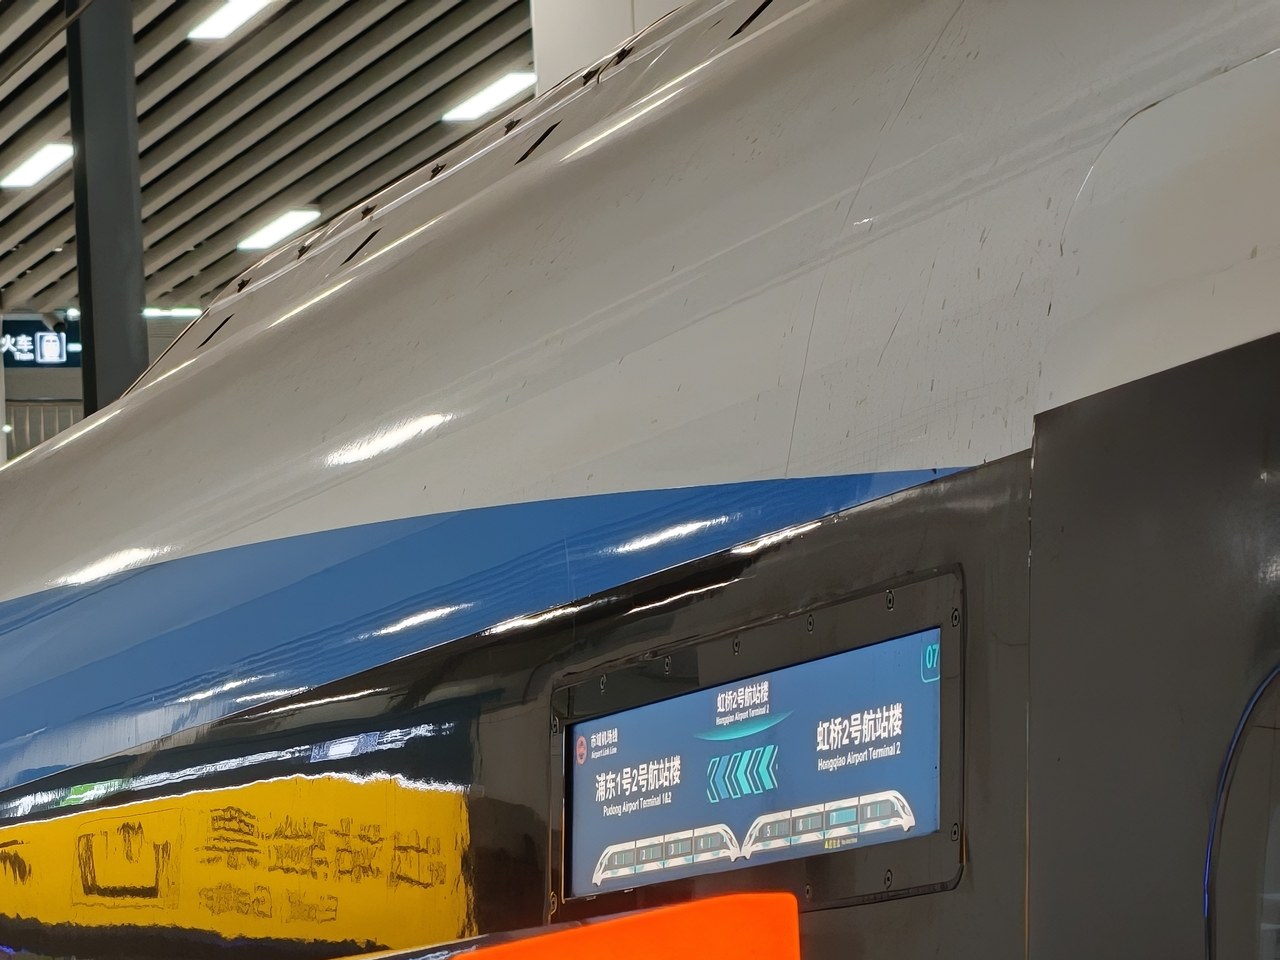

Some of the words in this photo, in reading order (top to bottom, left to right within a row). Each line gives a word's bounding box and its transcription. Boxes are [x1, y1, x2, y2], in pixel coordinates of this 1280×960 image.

[0, 334, 34, 352] 火车
[926, 643, 940, 669] 07
[717, 680, 769, 713] 虹桥2号航站楼
[590, 727, 618, 748] 市域机场线
[816, 702, 903, 752] 虹桥2号航站楼
[818, 755, 846, 771] Hongqiao
[847, 749, 868, 766] Airport
[869, 743, 896, 760] Terminal
[896, 741, 901, 755] 2
[595, 755, 681, 802] 浦东1号2号航站楼
[603, 804, 622, 817] Pudong
[622, 798, 640, 814] Airport
[640, 793, 661, 808] Terminal
